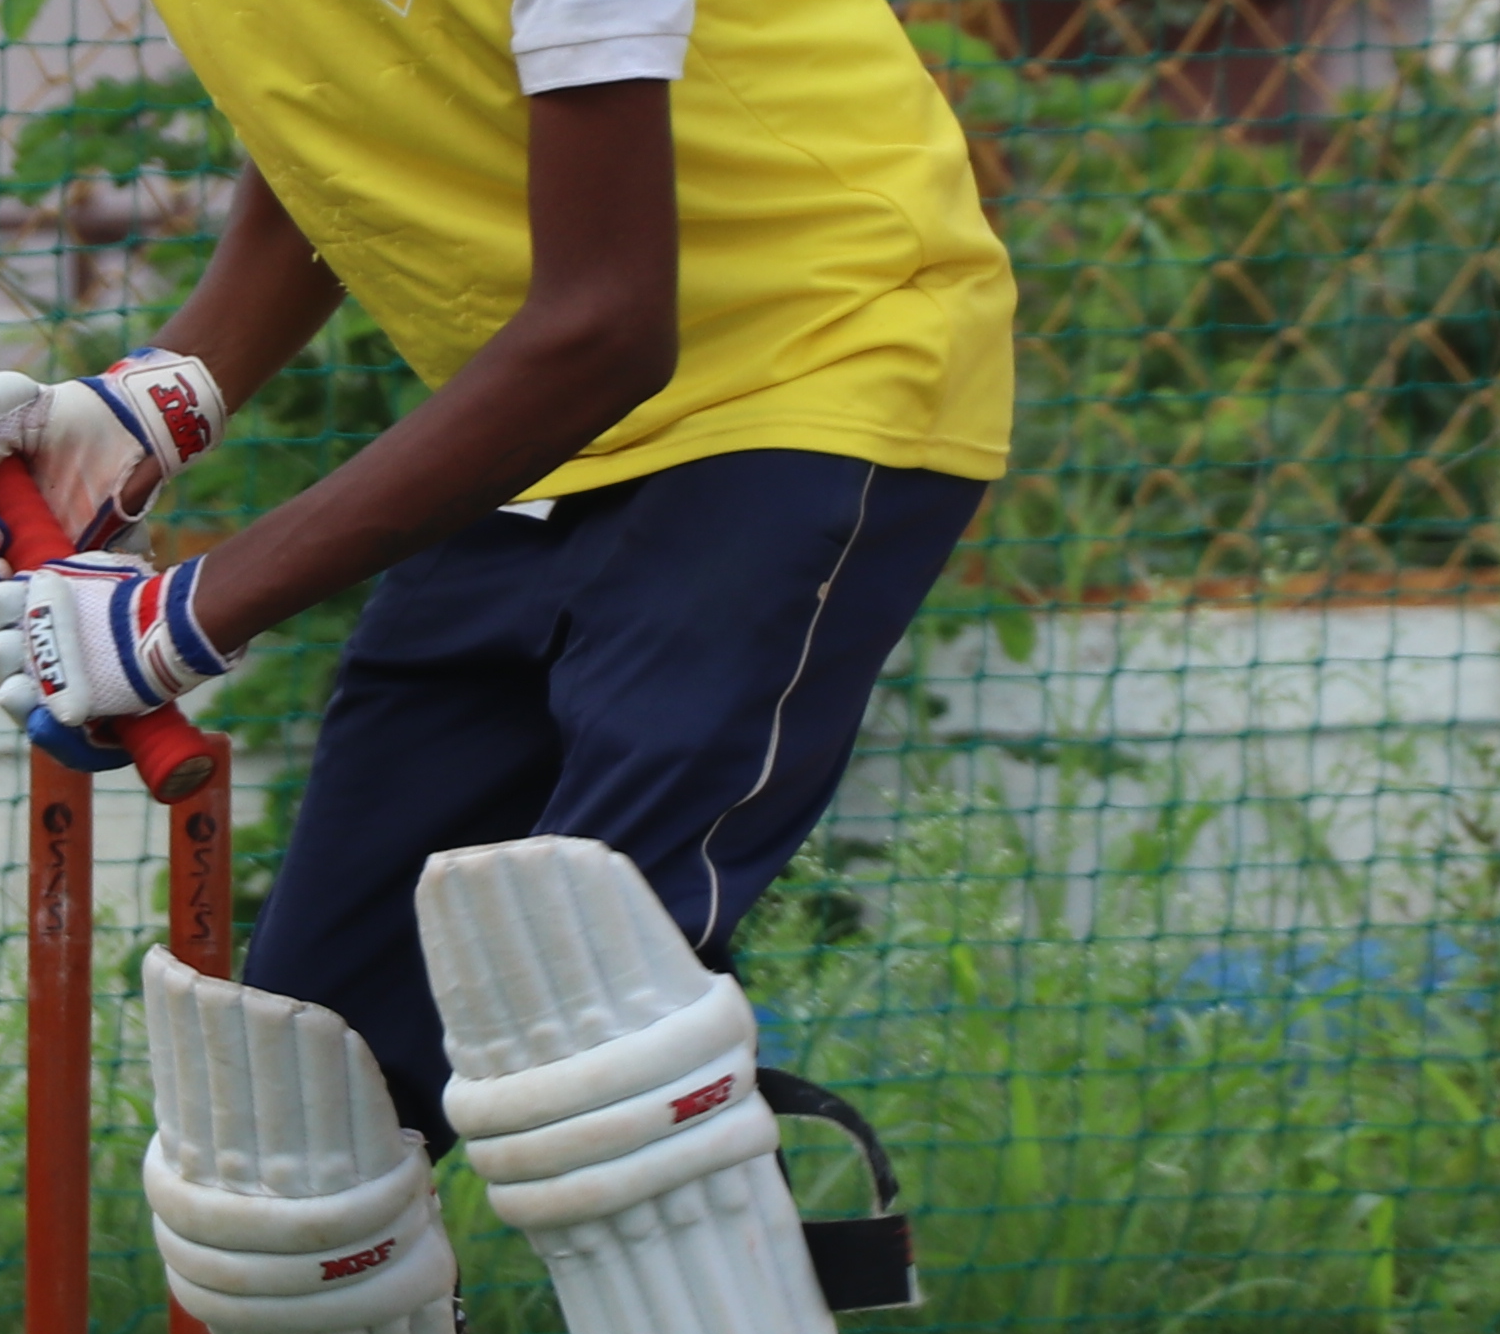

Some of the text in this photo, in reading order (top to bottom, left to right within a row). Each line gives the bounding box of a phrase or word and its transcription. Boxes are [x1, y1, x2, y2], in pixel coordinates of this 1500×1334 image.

[147, 384, 205, 463] MRF
[29, 615, 66, 685] MRF
[319, 1237, 396, 1281] MRF
